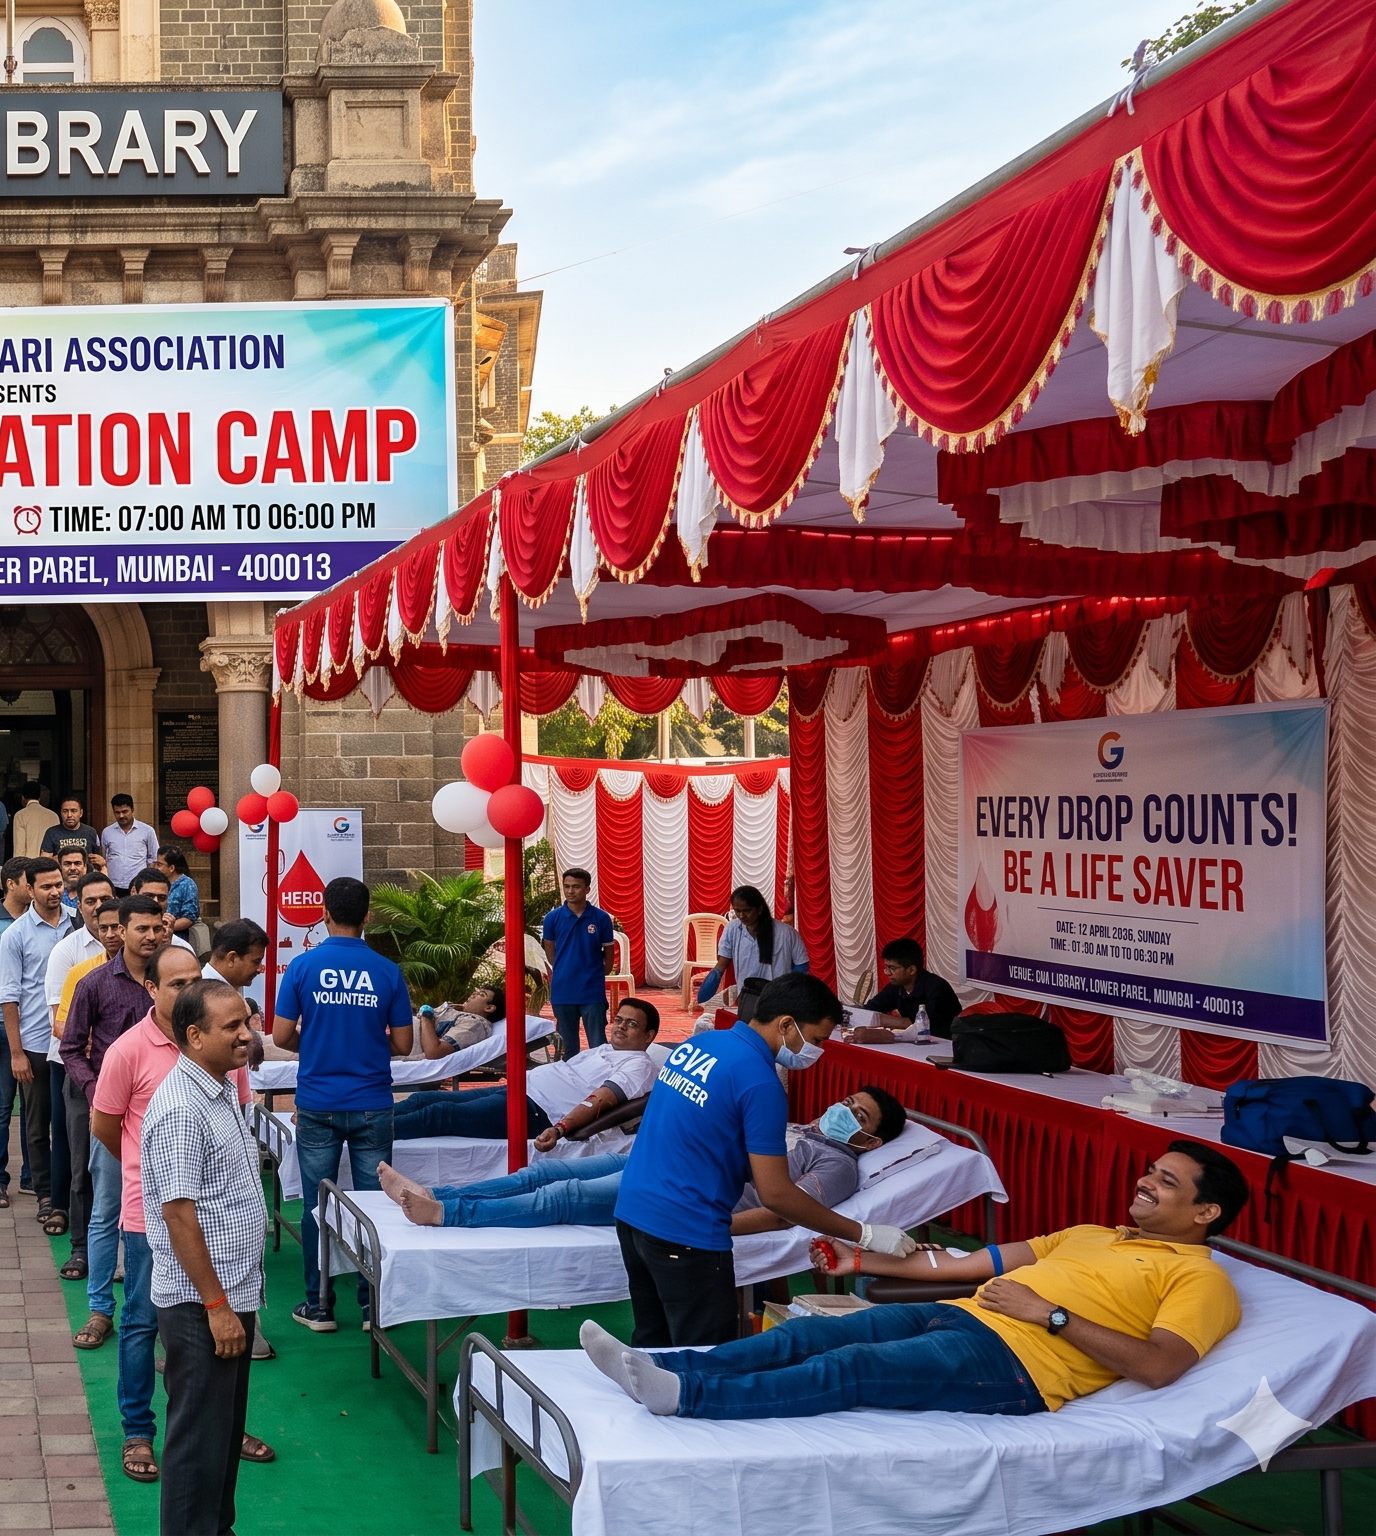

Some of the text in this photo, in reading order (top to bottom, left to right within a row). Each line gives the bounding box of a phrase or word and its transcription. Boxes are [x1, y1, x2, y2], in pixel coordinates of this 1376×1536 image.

[63, 334, 285, 373] ASSOCIATION
[216, 408, 417, 485] CAMP
[49, 502, 376, 533] TIME: 07:00 AM TO 06:00 PM
[28, 555, 109, 587] PAREL,
[116, 554, 214, 583] MUMBAI
[237, 552, 332, 582] 400013
[976, 792, 1298, 847] EVERY DROP COUNTS!
[282, 891, 324, 905] HERO
[1003, 849, 1245, 912] BE A LIFE SAVER
[1056, 920, 1076, 934] DATE:
[1078, 923, 1088, 936] 12
[1137, 929, 1172, 946] SUNDAY
[1095, 943, 1109, 957] AM
[1110, 944, 1120, 958] TO
[1121, 946, 1132, 960] TO
[1133, 948, 1158, 964] 06:30
[1160, 951, 1174, 966] PM
[319, 968, 374, 991] GVA
[312, 990, 378, 1008] VOLUNTEER
[1089, 978, 1119, 997] LOWER
[1120, 983, 1151, 1004] PAREL,
[1153, 988, 1194, 1009] MUMBAI
[1202, 995, 1245, 1017] 400013
[669, 1042, 718, 1084] GVA
